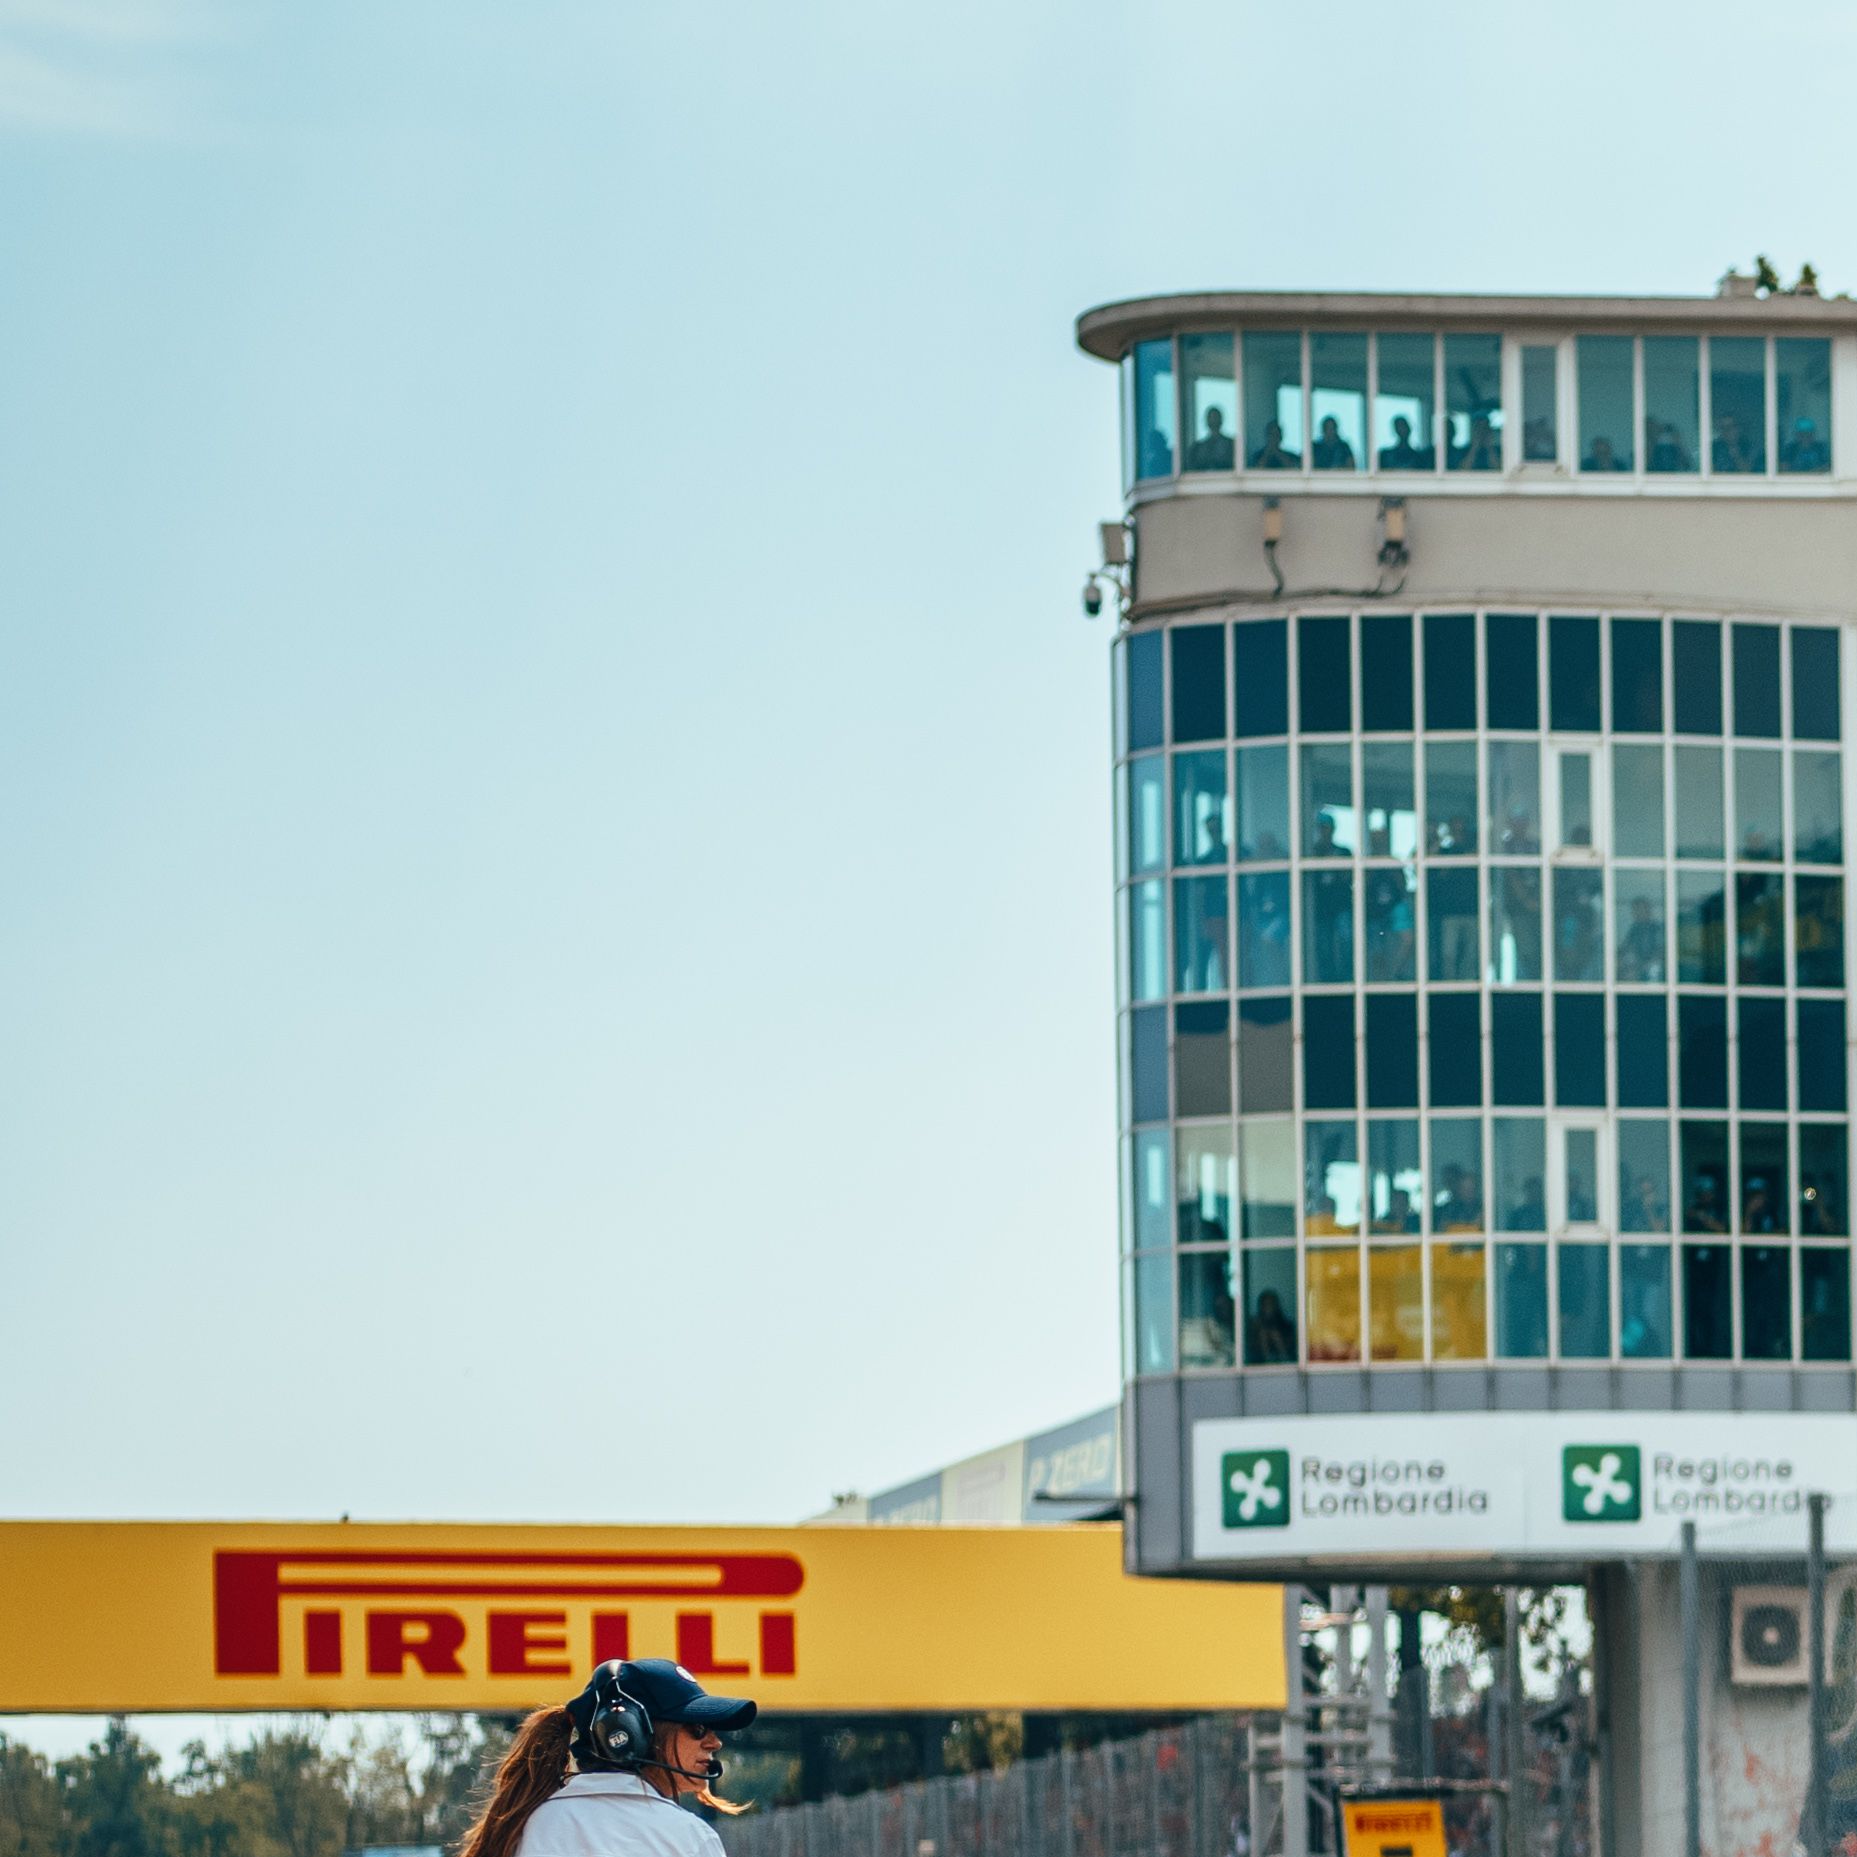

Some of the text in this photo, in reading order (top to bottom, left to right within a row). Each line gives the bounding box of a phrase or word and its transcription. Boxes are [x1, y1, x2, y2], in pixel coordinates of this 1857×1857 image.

[1302, 1457, 1446, 1488] Regione
[1654, 1455, 1794, 1486] Regione
[1302, 1486, 1488, 1516] Lombardia
[1654, 1485, 1832, 1515] Lombard
[213, 1550, 804, 1676] PIRELLI
